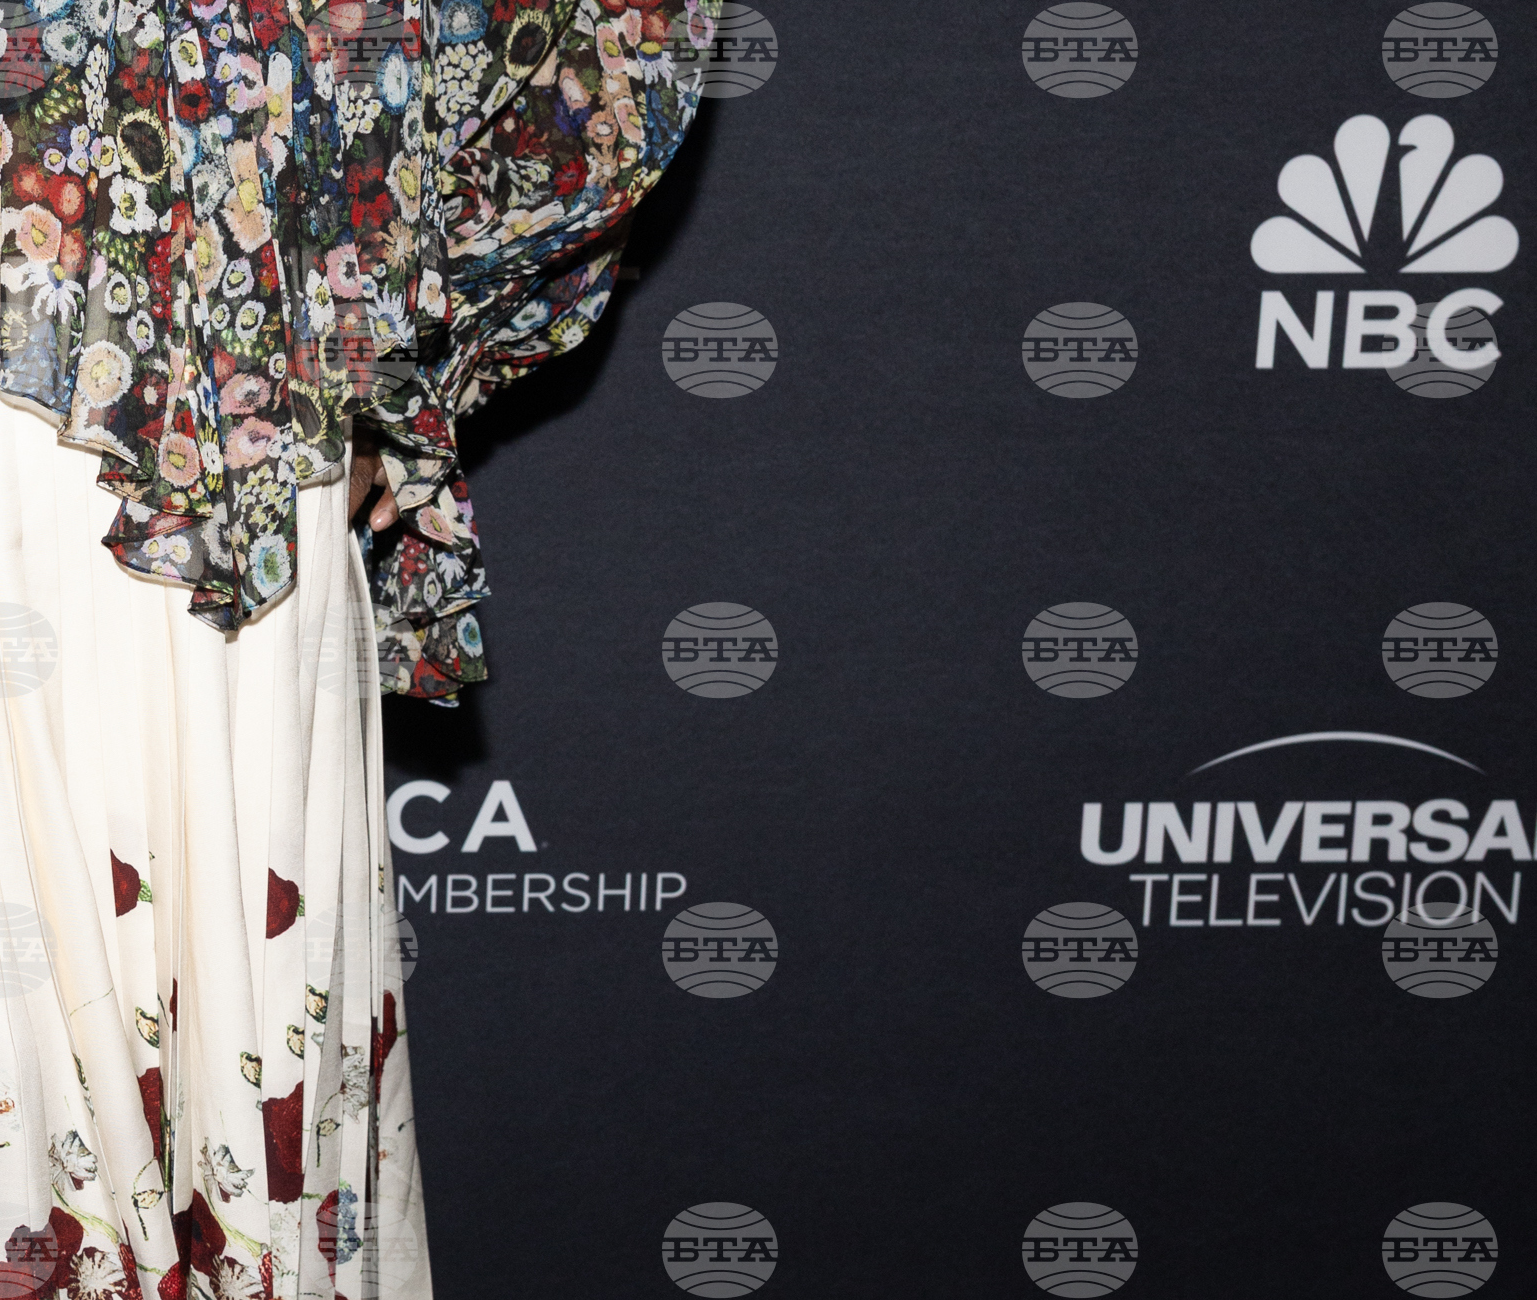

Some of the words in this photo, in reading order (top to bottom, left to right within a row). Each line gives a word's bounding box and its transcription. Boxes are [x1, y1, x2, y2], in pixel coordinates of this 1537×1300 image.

[1257, 289, 1503, 369] NBC
[1080, 800, 1537, 865] UNIVERSA
[1130, 871, 1520, 926] TELEVISION
